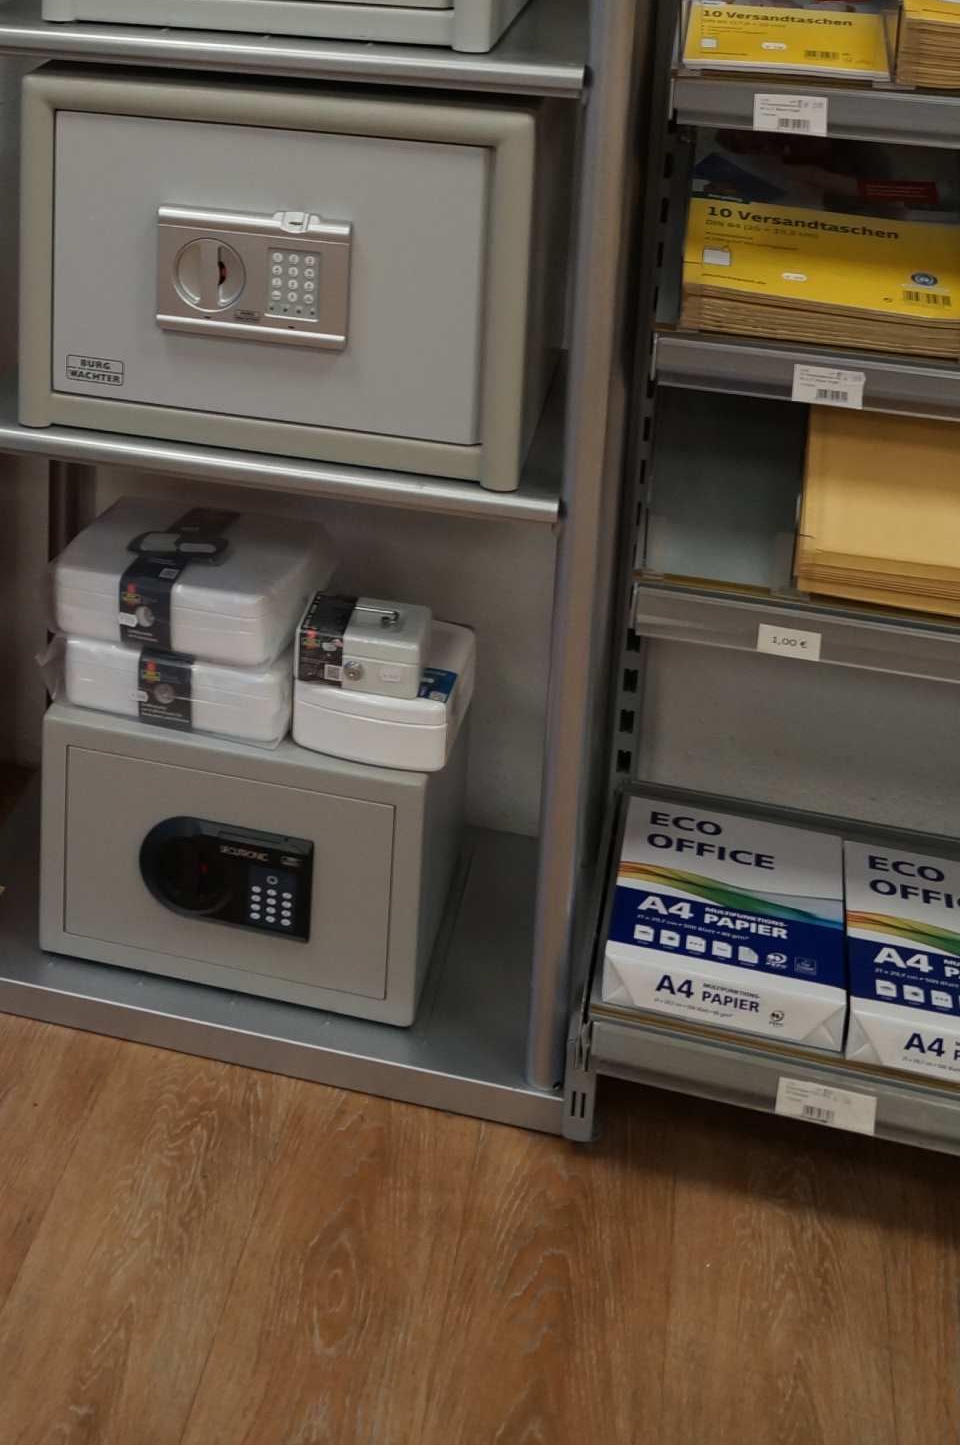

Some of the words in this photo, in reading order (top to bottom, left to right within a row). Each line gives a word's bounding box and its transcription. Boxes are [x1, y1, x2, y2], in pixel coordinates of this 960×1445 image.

[703, 10, 722, 18] 10
[726, 11, 853, 27] Versandtaschen
[707, 205, 733, 219] 10
[737, 210, 900, 241] Versandtaschen
[80, 358, 111, 371] BURG
[650, 810, 723, 837] ECO
[646, 833, 776, 871] OFFICE
[867, 854, 945, 883] ECO
[869, 878, 960, 910] OFFI
[637, 895, 694, 920] A4
[704, 906, 789, 927] MULTIFUNKTIONS-
[703, 913, 789, 940] PAPIER
[873, 947, 934, 973] A4
[656, 974, 694, 999] A4
[703, 981, 761, 999] MULTIFUNKTIONS-
[701, 990, 760, 1013] PAPIER
[904, 1032, 946, 1057] A4
